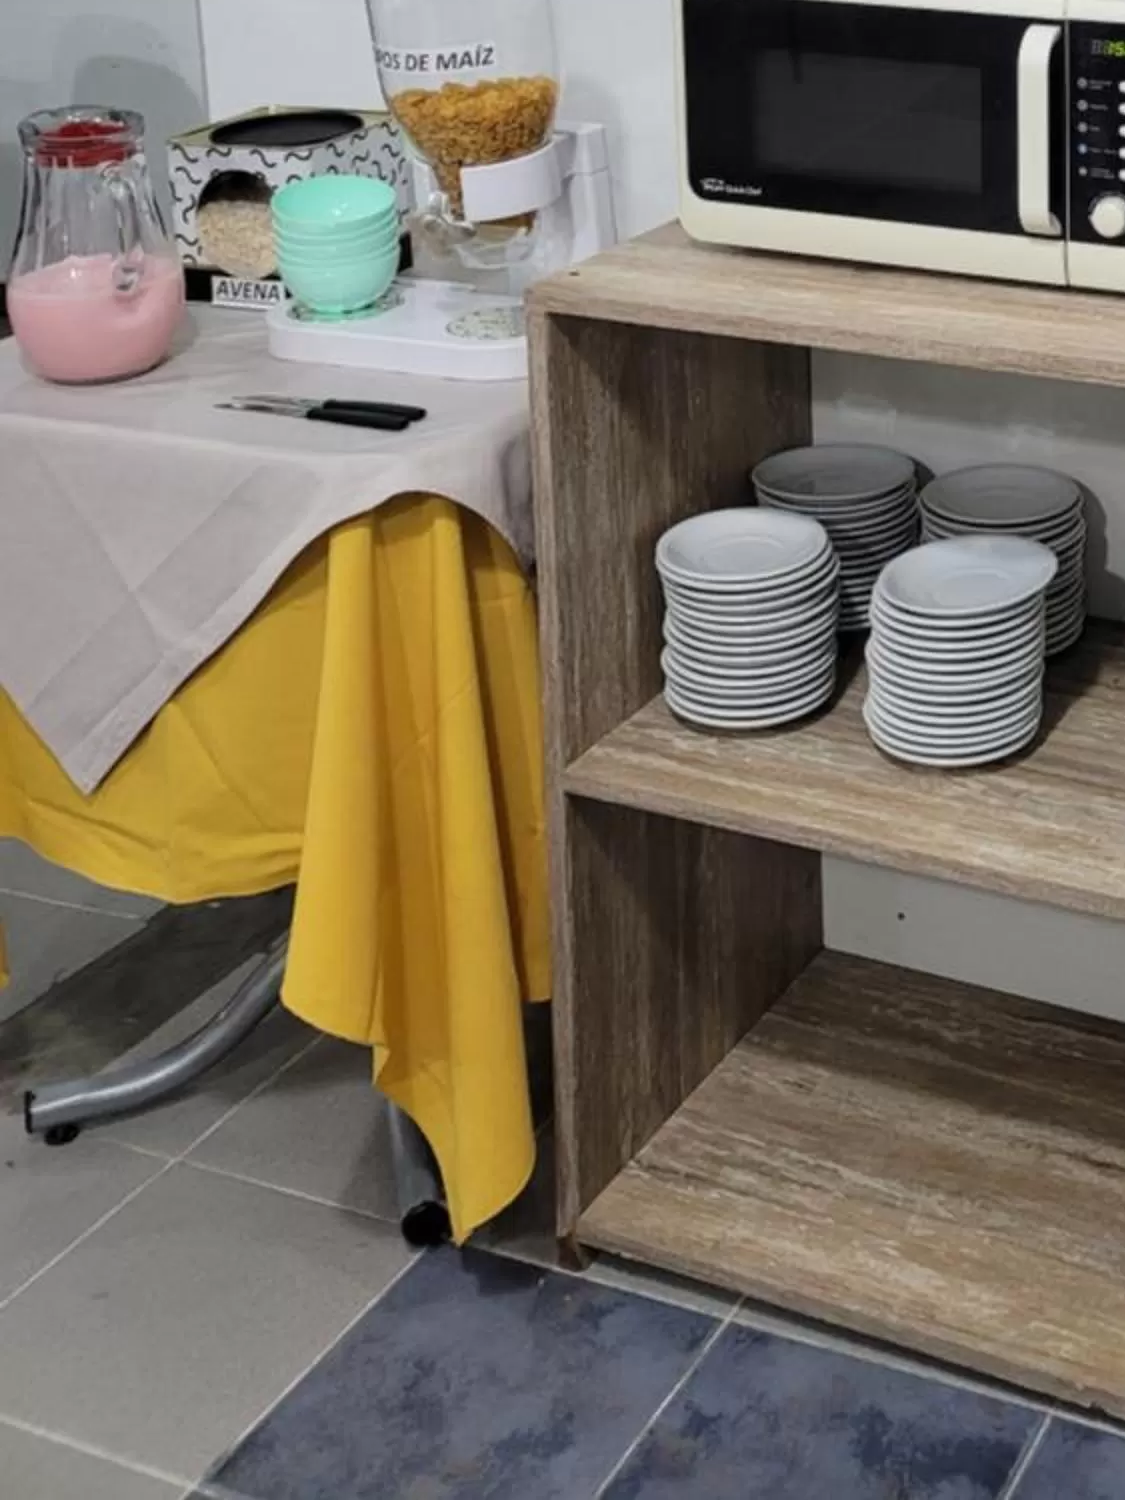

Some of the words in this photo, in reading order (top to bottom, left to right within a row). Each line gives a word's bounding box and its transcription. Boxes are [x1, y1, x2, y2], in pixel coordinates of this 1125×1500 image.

[405, 52, 430, 71] DE
[435, 43, 495, 71] MAÍZ
[216, 279, 281, 301] AVENA
